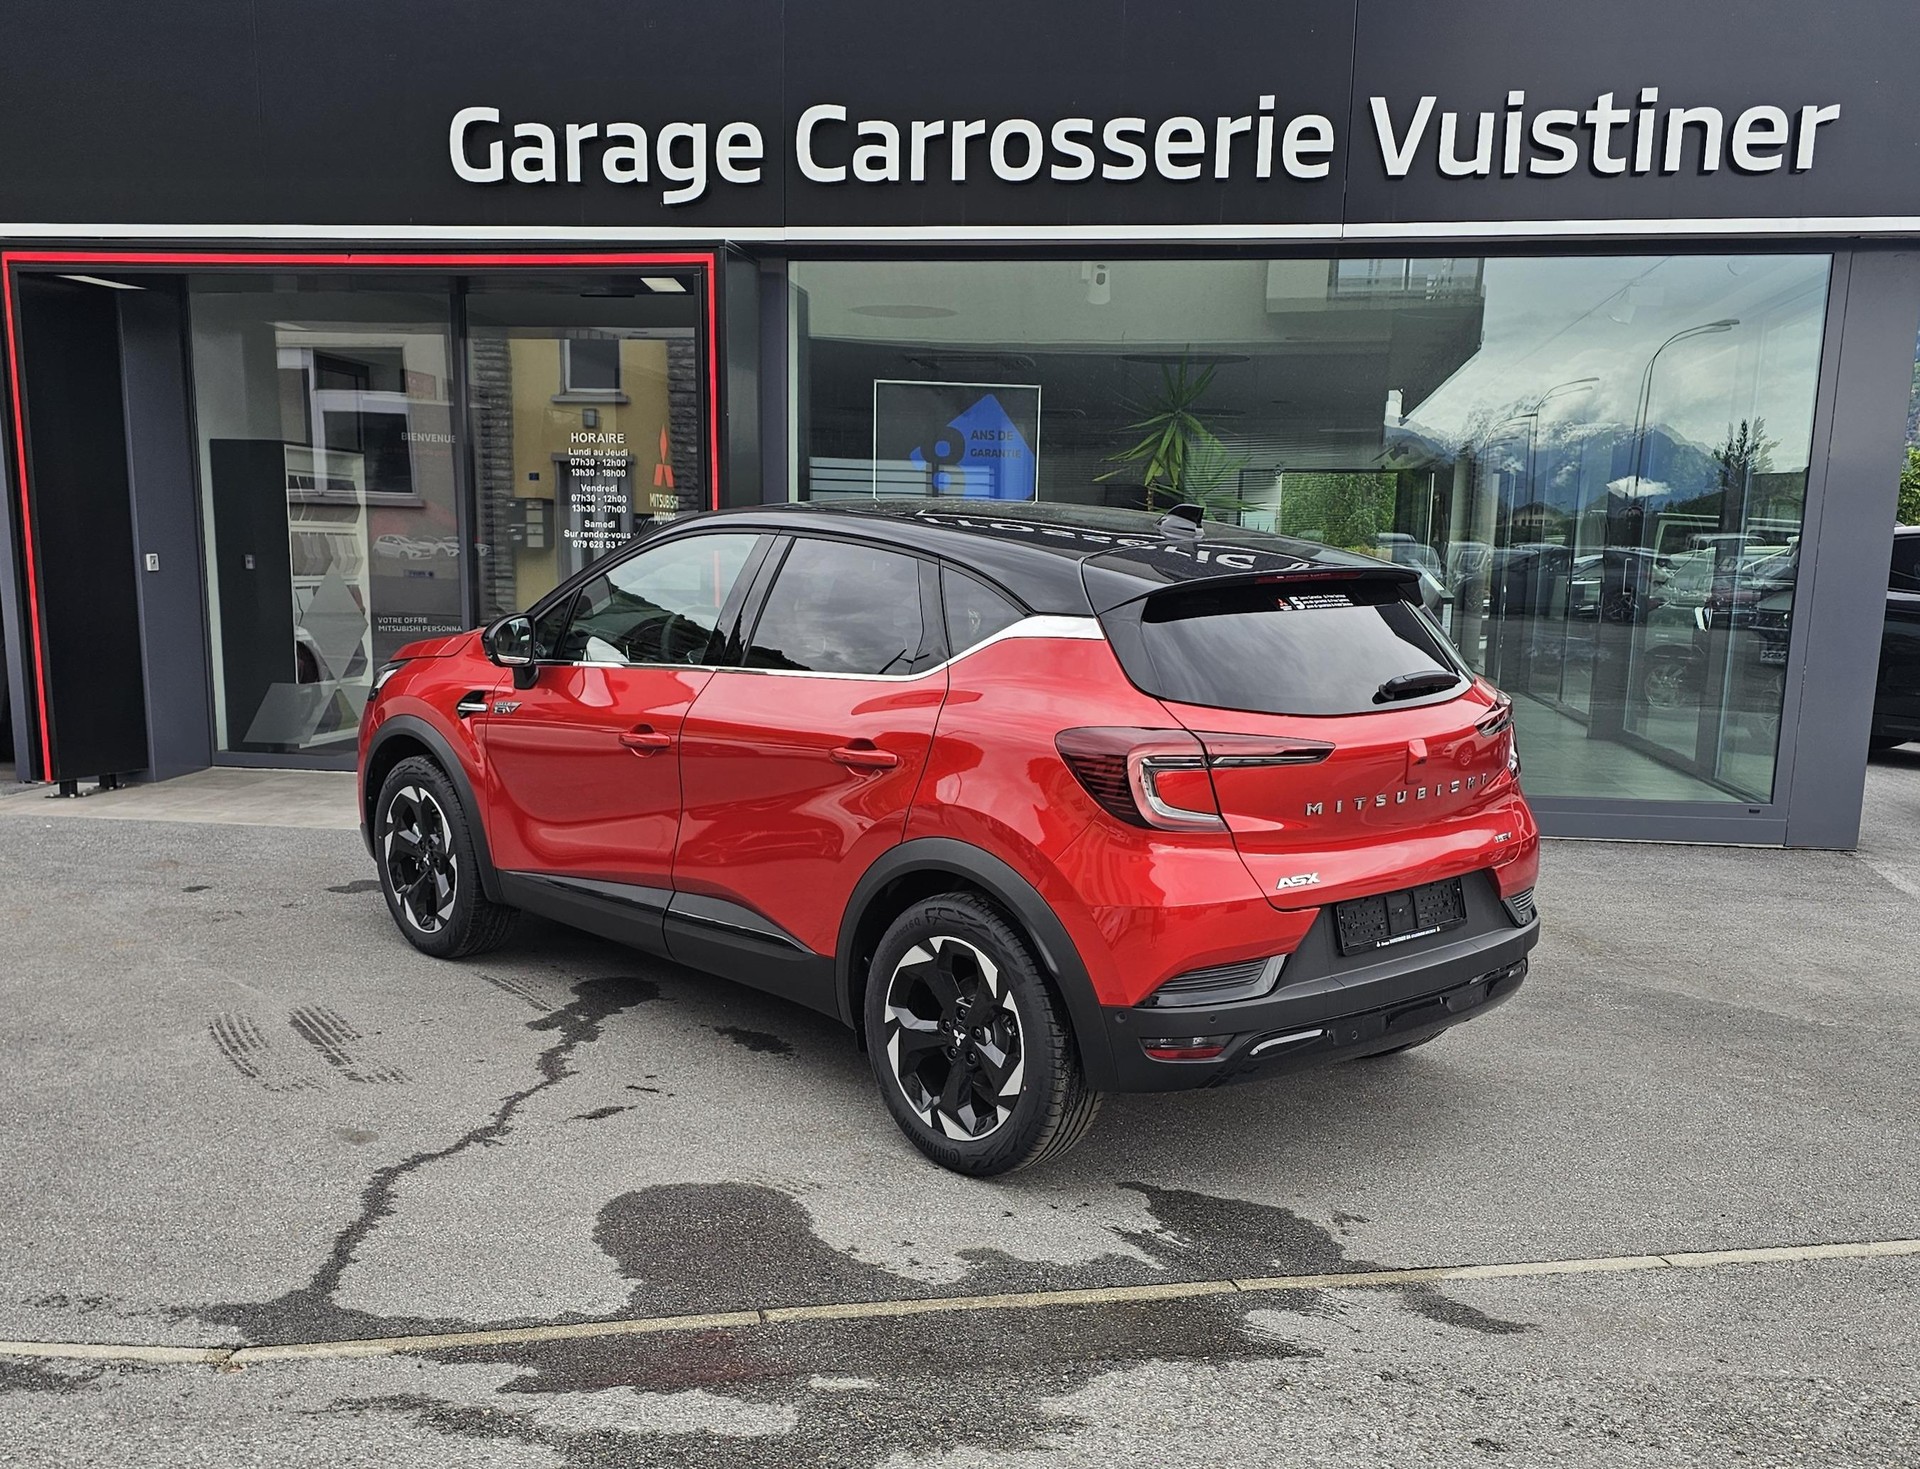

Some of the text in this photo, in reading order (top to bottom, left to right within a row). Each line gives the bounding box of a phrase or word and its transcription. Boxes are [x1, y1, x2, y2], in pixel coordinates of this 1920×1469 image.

[449, 86, 1841, 205] Garage Carrosserie Vuistiner
[401, 431, 456, 444] BIENVENUE
[570, 432, 625, 444] HORAIRE
[970, 430, 1013, 441] ANS DE
[568, 447, 592, 456] Lundi
[605, 448, 628, 457] Jeudi
[970, 448, 1021, 459] GARANTIE
[570, 457, 596, 466] 07h30
[602, 458, 627, 467] 12h00
[571, 468, 595, 477] 13h30
[602, 469, 627, 477] 18h00
[580, 483, 618, 493] Vendredi
[571, 493, 596, 502] 07h30
[602, 494, 627, 503] 12h00
[571, 503, 596, 512] 13h30
[602, 505, 627, 513] 17h00
[584, 519, 616, 528] Samedi
[564, 529, 632, 539] Sur rendez-vous
[572, 539, 588, 548] 079
[605, 540, 616, 549] 53
[377, 616, 428, 624] VOTRE OFFRE
[1305, 772, 1488, 817] MITSUBISHI
[1276, 871, 1322, 891] ASX
